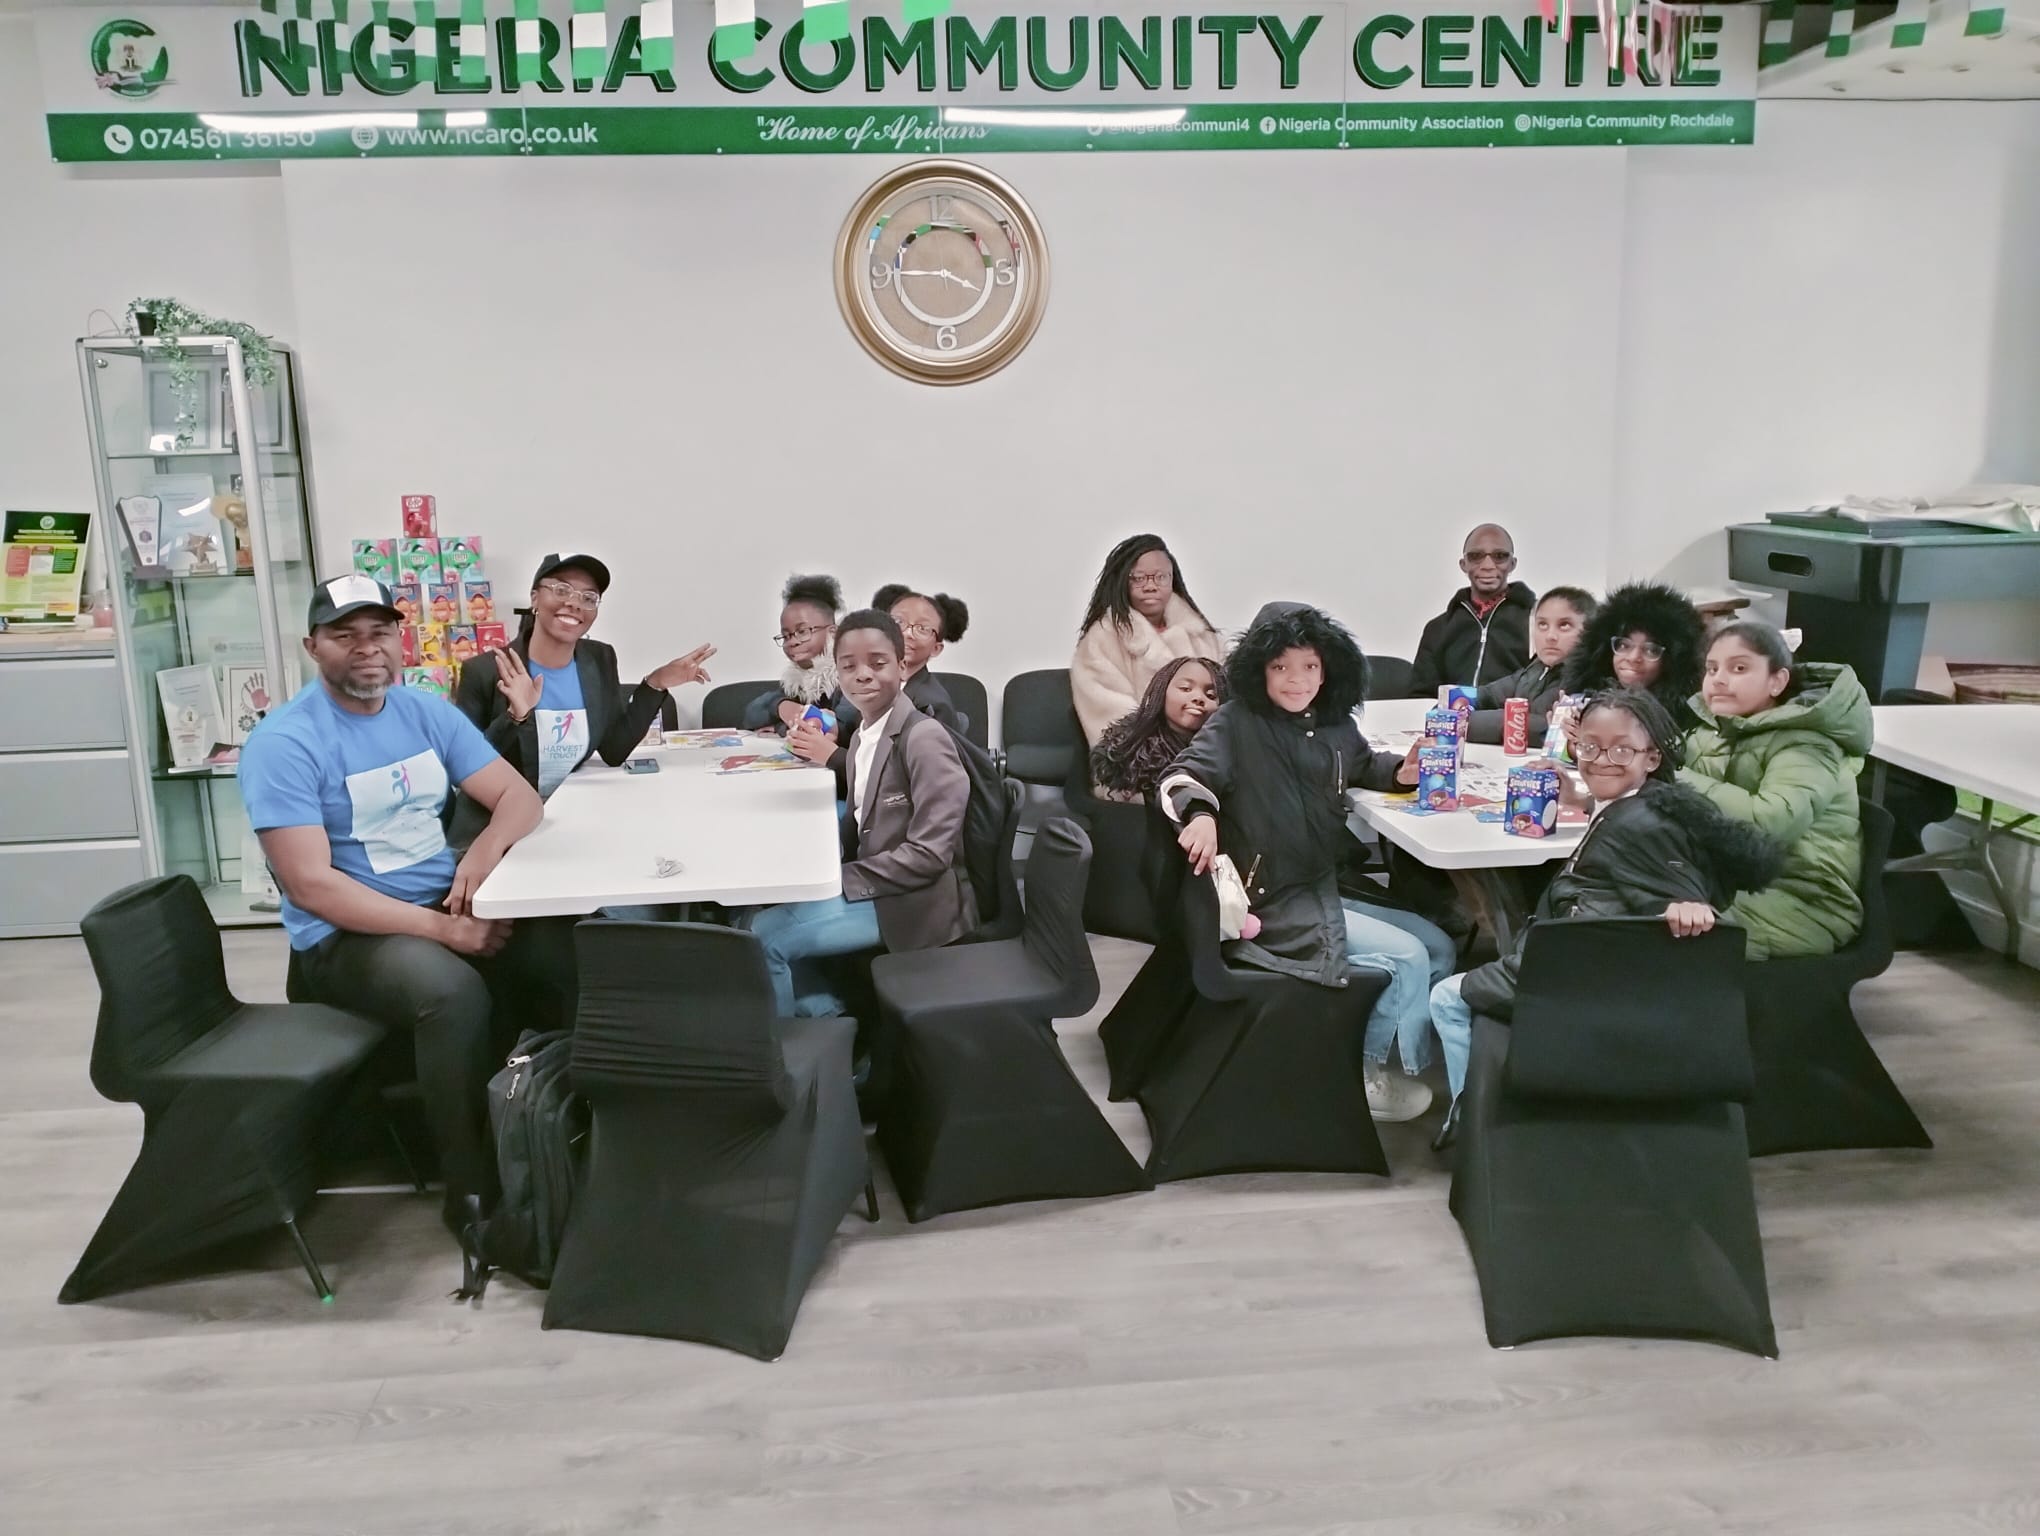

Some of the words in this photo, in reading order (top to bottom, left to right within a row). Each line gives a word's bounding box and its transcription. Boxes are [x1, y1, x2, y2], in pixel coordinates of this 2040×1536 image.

[234, 16, 677, 97] NIGERA
[708, 15, 1324, 93] COMMUNITY
[1353, 14, 1723, 90] CENTRE
[385, 121, 599, 145] www.ncaro.co.uk
[844, 115, 875, 150] of
[874, 114, 990, 150] Africans
[1279, 117, 1330, 132] Nigeria
[1335, 116, 1418, 132] Community
[1422, 115, 1504, 130] Association
[1586, 114, 1665, 130] Community
[1670, 114, 1735, 127] Rochdale
[139, 128, 232, 149] 074561
[930, 195, 954, 221] 12
[871, 262, 892, 289] 9
[995, 258, 1015, 285] 3
[936, 326, 958, 350] 6
[1507, 712, 1526, 751] Cola
[543, 744, 583, 753] HARVEST
